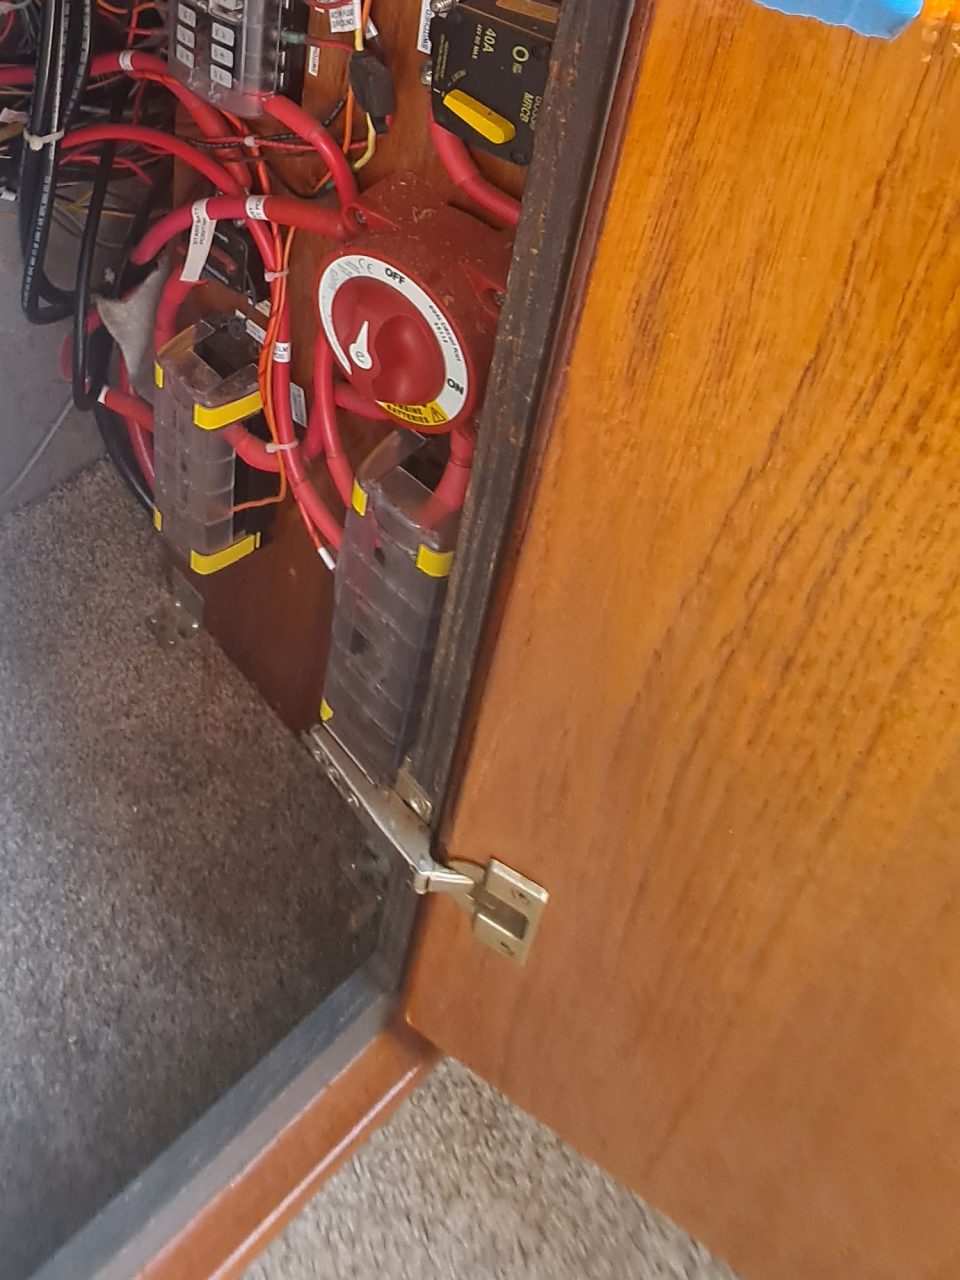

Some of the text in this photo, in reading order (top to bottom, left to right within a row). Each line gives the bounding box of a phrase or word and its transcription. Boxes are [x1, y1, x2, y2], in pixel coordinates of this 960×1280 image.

[483, 27, 497, 53] 40A
[384, 267, 405, 285] OFF
[446, 377, 465, 396] ON
